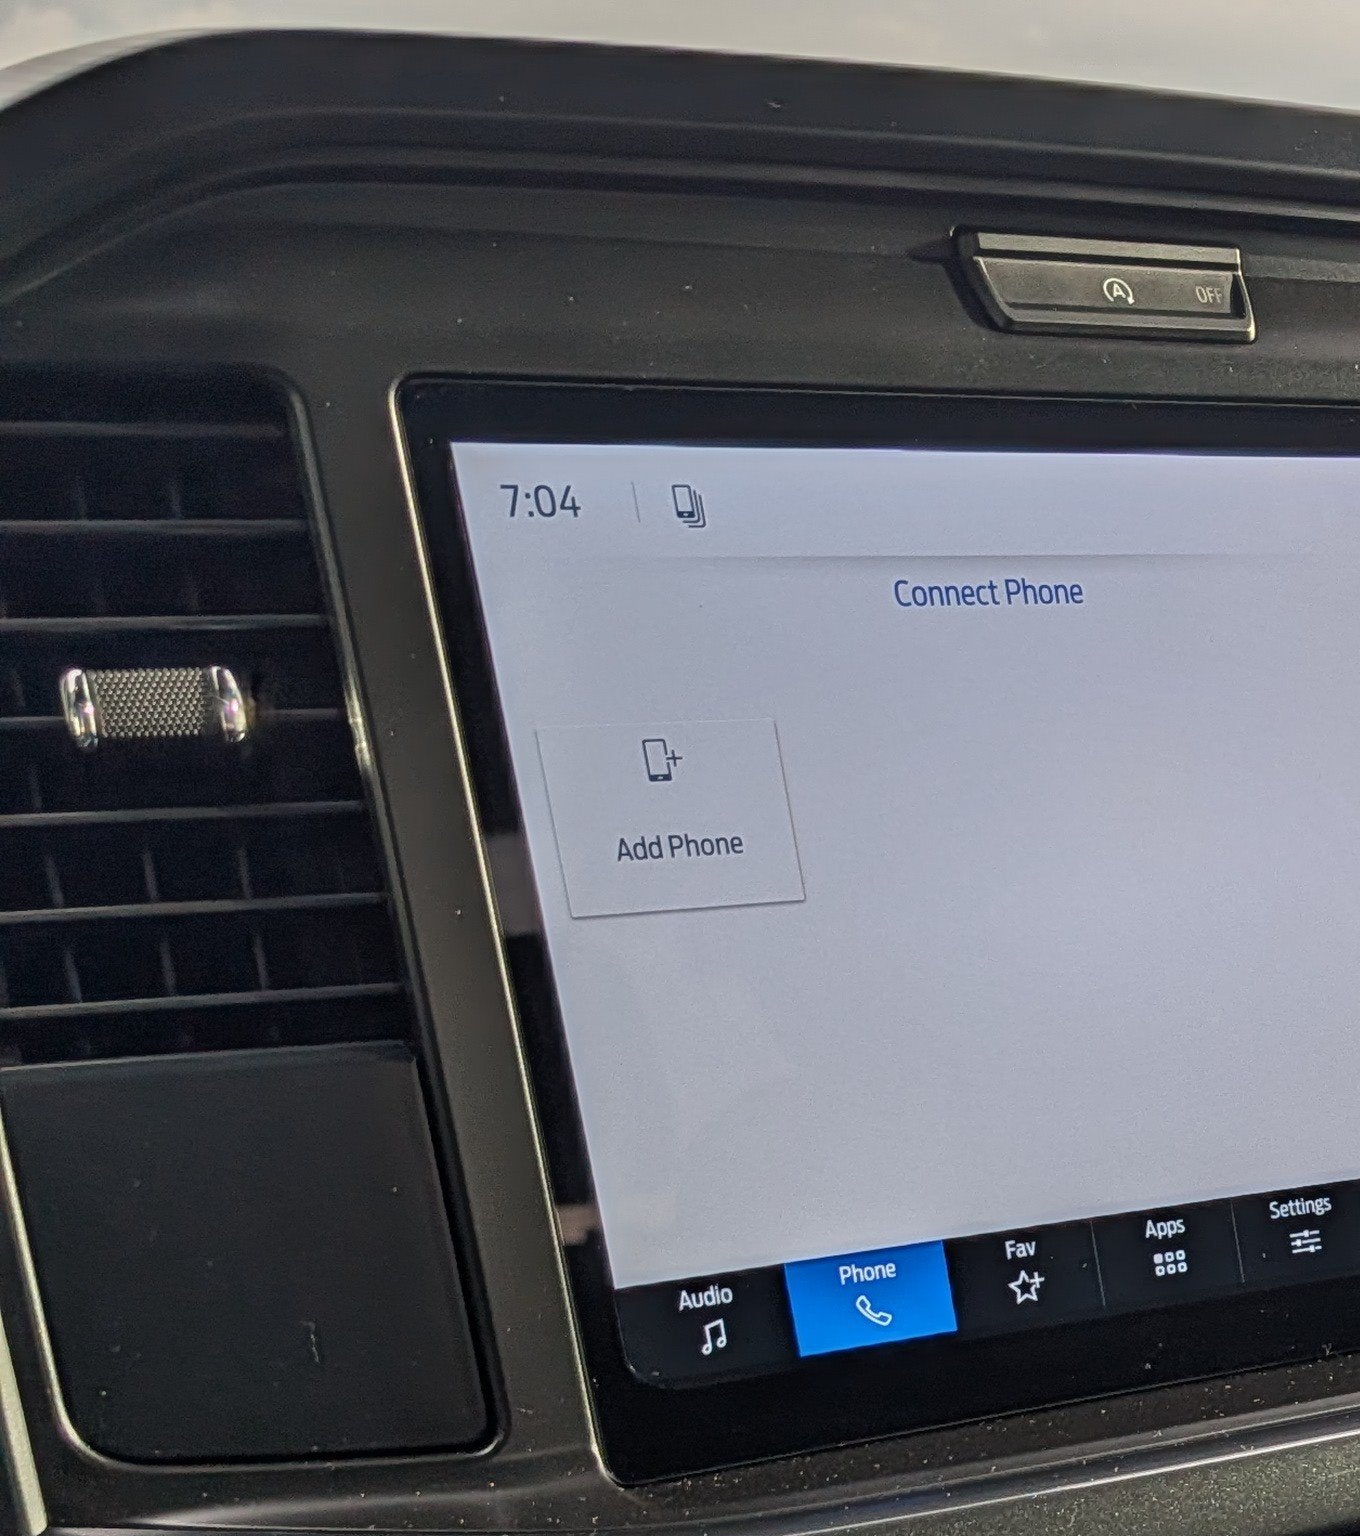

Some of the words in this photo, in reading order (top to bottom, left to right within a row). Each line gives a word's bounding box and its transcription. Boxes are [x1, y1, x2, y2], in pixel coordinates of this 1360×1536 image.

[1195, 285, 1223, 304] OFF
[499, 484, 581, 519] 7:04
[894, 579, 1001, 607] Connect
[1004, 577, 1085, 605] Phone
[616, 835, 664, 863] Add
[668, 832, 745, 859] Phone
[1268, 1194, 1332, 1221] Settings
[1144, 1216, 1187, 1240] Apps
[1004, 1237, 1037, 1260] Fav
[838, 1259, 897, 1285] Phone
[678, 1283, 734, 1312] Audio
